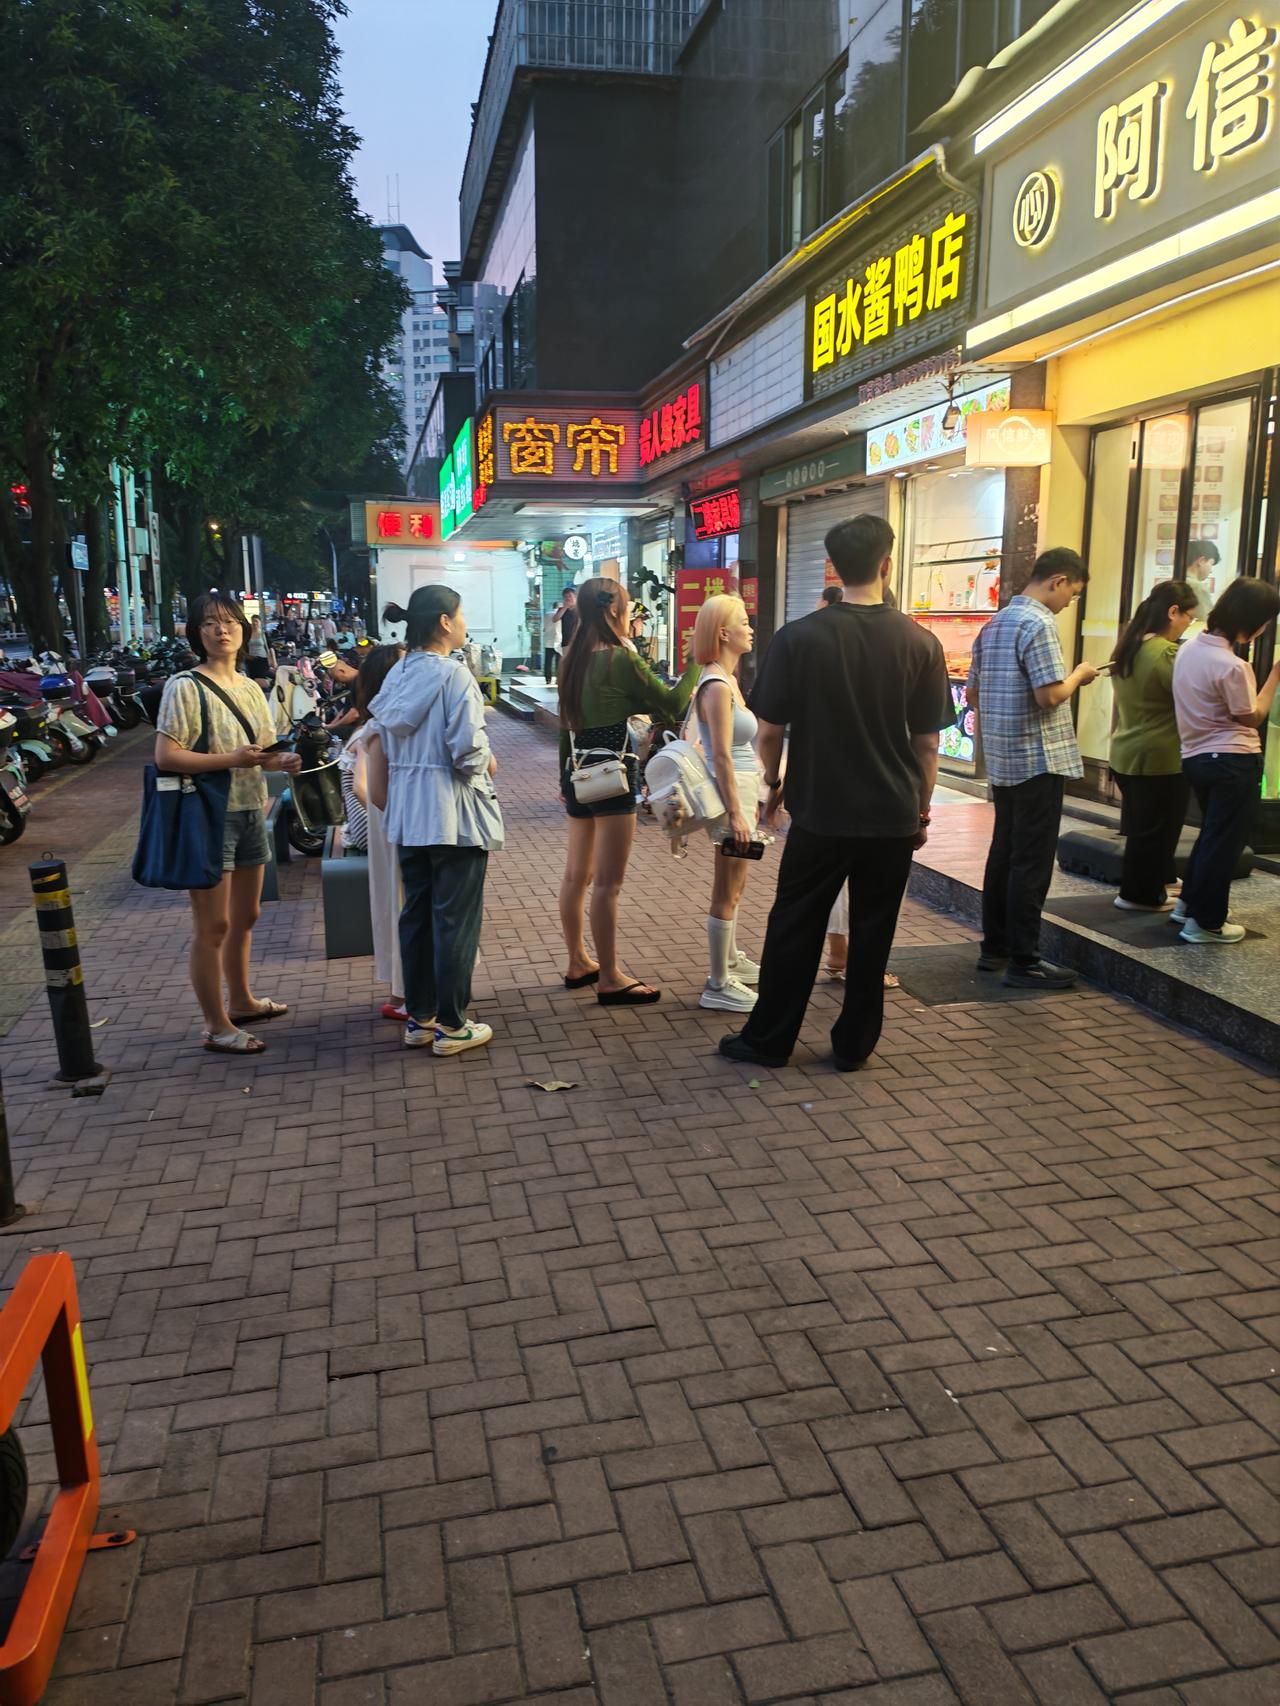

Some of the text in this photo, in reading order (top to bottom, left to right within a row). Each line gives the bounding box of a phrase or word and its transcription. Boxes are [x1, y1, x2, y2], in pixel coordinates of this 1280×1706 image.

[1094, 18, 1271, 218] 阿信
[813, 212, 966, 372] 国水酱鸭店
[503, 416, 625, 476] 窗帘
